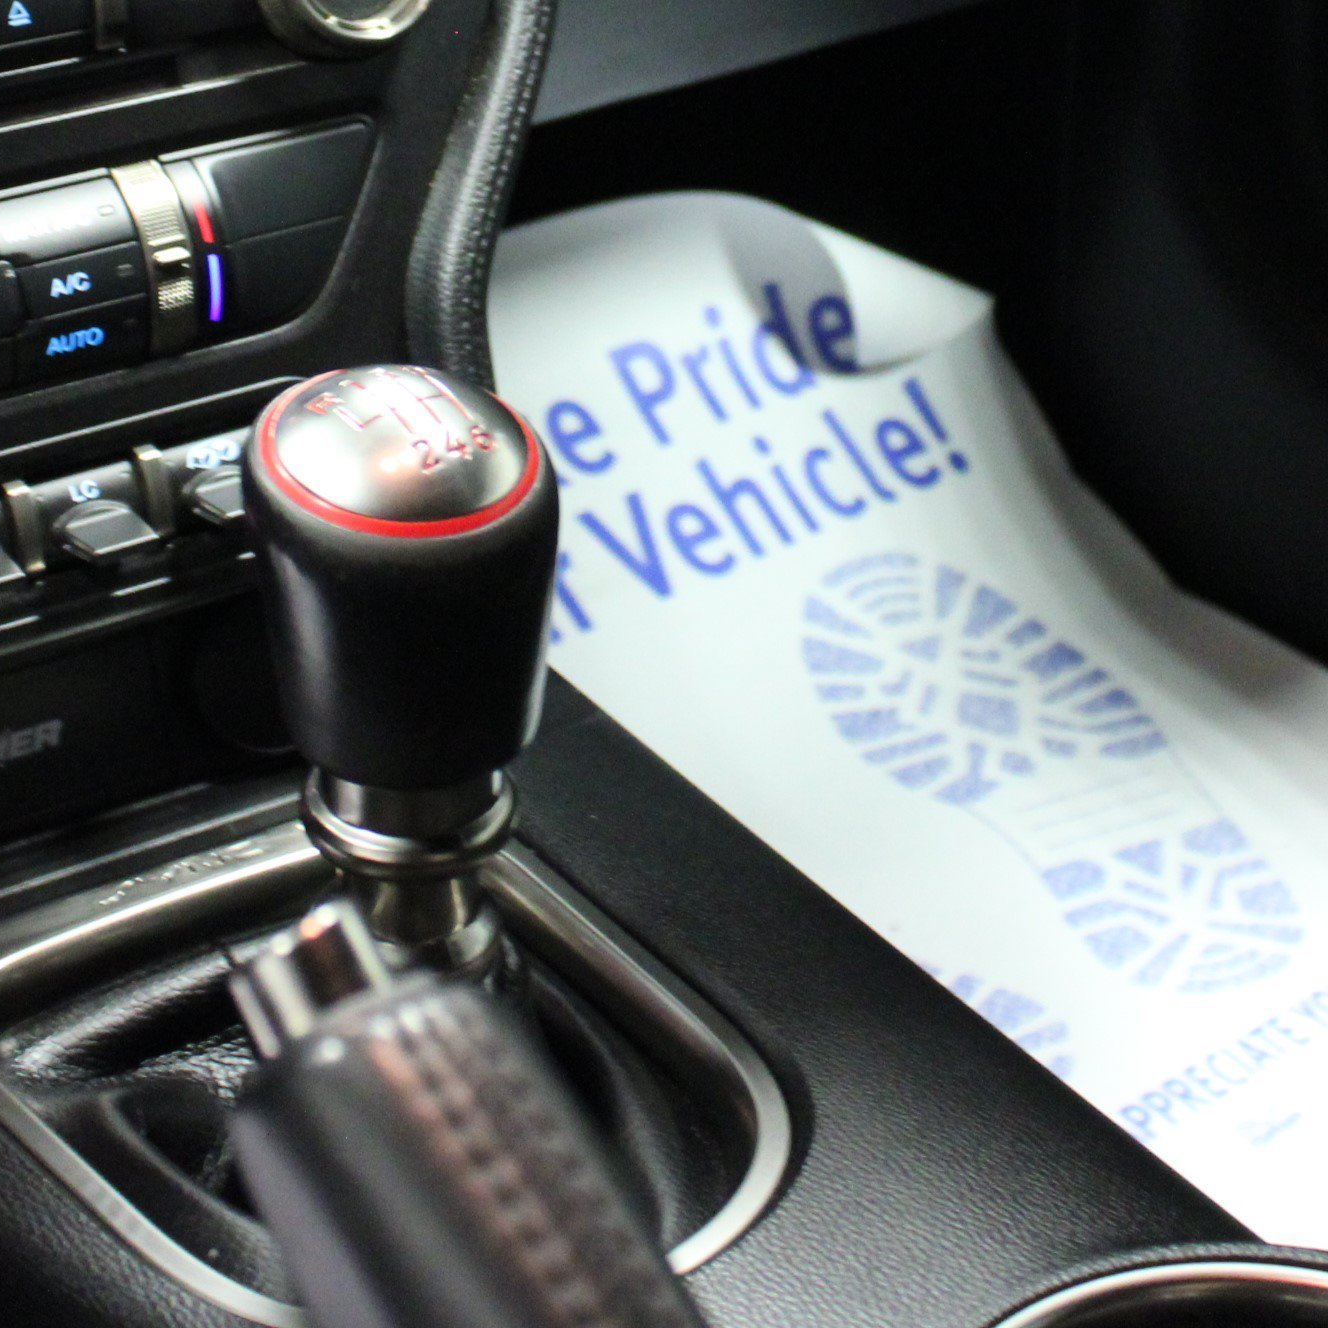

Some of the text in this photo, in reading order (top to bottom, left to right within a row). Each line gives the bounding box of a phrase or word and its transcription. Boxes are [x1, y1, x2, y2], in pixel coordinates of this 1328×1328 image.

[51, 271, 92, 298] A/C
[46, 326, 104, 357] AUTO
[608, 282, 860, 447] Pride
[577, 377, 968, 598] Vehicle!
